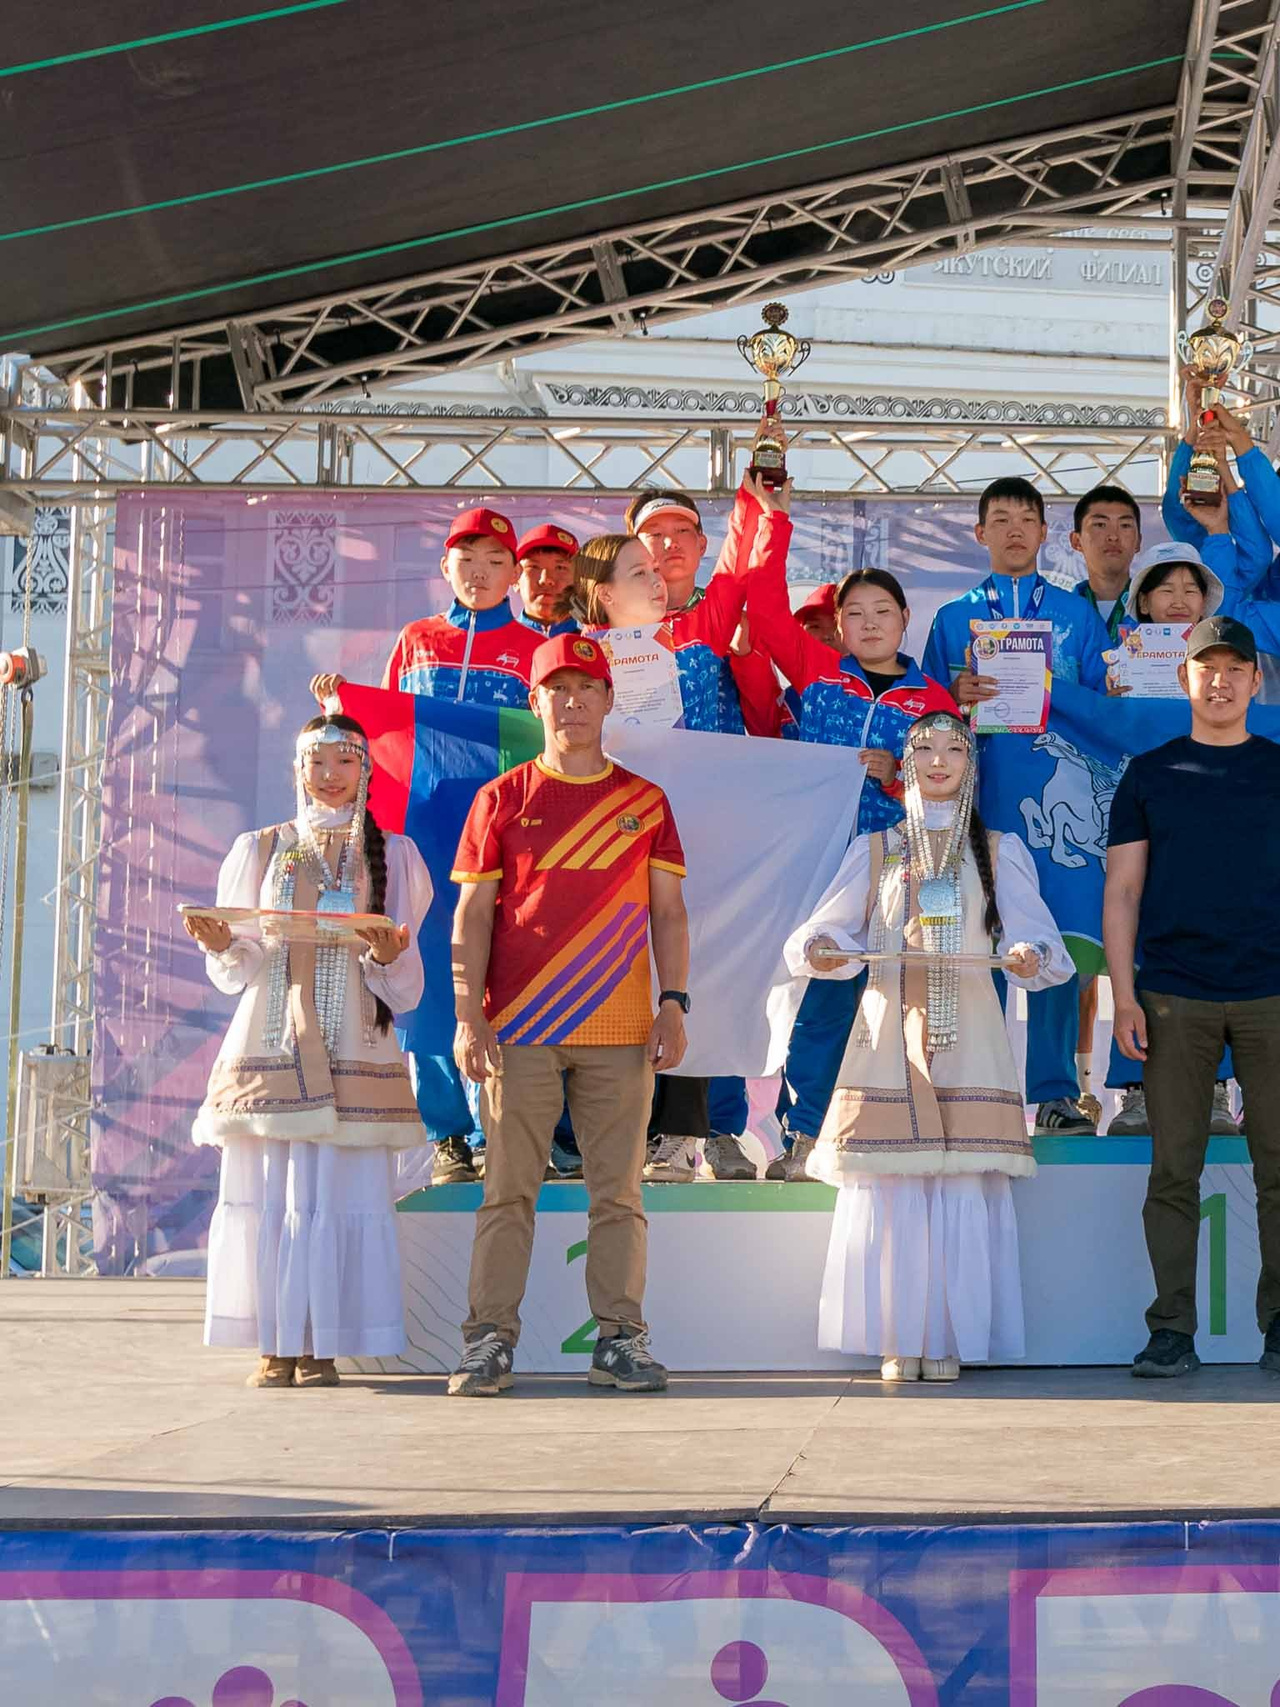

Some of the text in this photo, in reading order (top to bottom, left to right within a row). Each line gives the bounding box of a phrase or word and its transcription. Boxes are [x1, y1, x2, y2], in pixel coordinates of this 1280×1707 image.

[933, 252, 1163, 287] ЯКУТСКИЙ ФИЛИАЛ
[1000, 637, 1044, 651] ГРАМОТА
[1136, 651, 1185, 659] ГРАМОТА
[1199, 1193, 1227, 1335] 1
